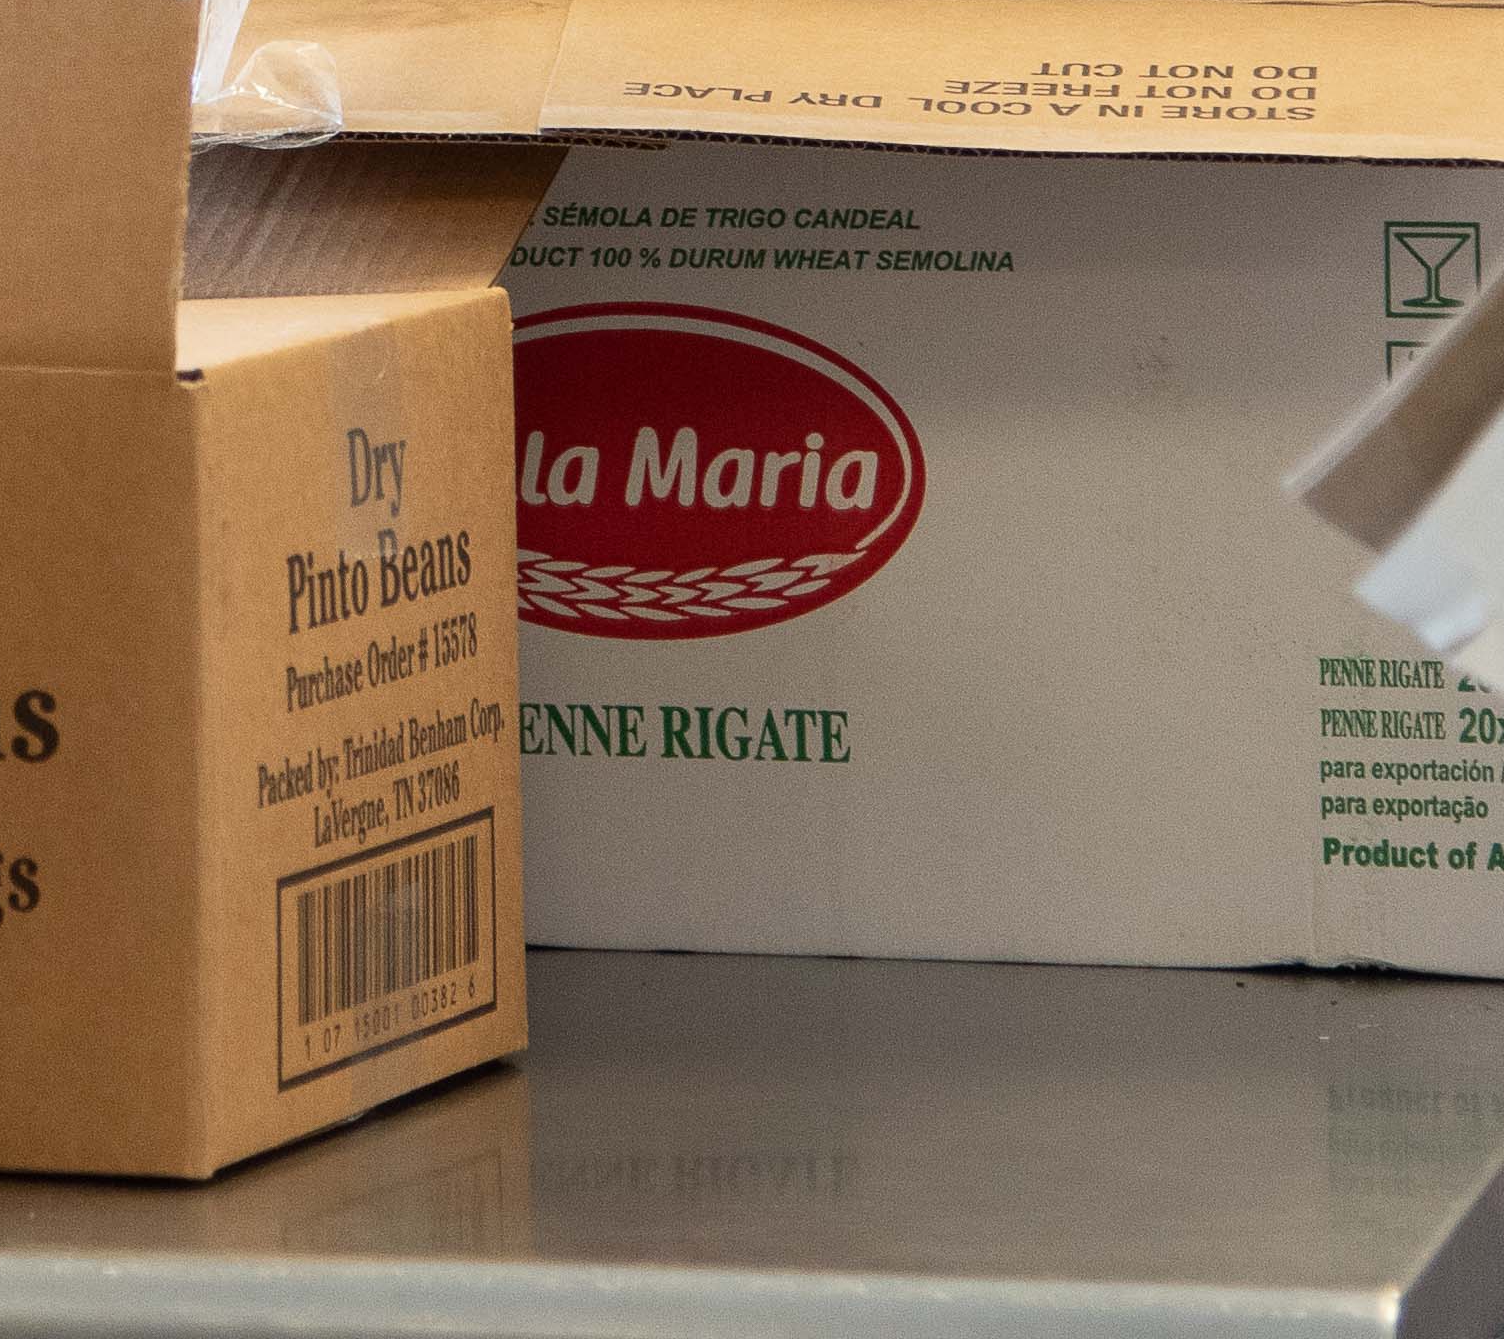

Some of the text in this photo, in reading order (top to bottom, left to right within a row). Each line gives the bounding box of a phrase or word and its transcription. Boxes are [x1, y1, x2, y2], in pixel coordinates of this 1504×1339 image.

[1031, 62, 1317, 79] DO NOT CUT
[623, 82, 1315, 120] STORE IN A COOL DRY PLACE
[944, 79, 1315, 99] DO NOT FREEZE
[543, 202, 920, 229] SÉMOLA DE TRIGO CANDEAL
[510, 246, 1013, 271] DUCT 100 % DURUM WHEAT SEMOLINA
[346, 427, 406, 518] Dry
[625, 426, 878, 510] Maria
[286, 527, 471, 634] Pinto Beans
[286, 612, 477, 713] Purchase Order # 15578
[1319, 658, 1375, 687] PENNE
[1379, 659, 1444, 689] RIGATE
[519, 703, 850, 763] ENNE RIGATE
[1320, 708, 1377, 737] PENNE
[1380, 710, 1446, 739] RIGATE
[258, 698, 505, 808] Packed by: Trinidad Benham Corp.
[1320, 760, 1365, 783] para
[1371, 759, 1494, 785] exportación
[313, 762, 460, 848] LaVergne, TN 37086
[1321, 795, 1488, 822] para exportação
[1323, 837, 1438, 869] Product
[1448, 841, 1476, 869] of
